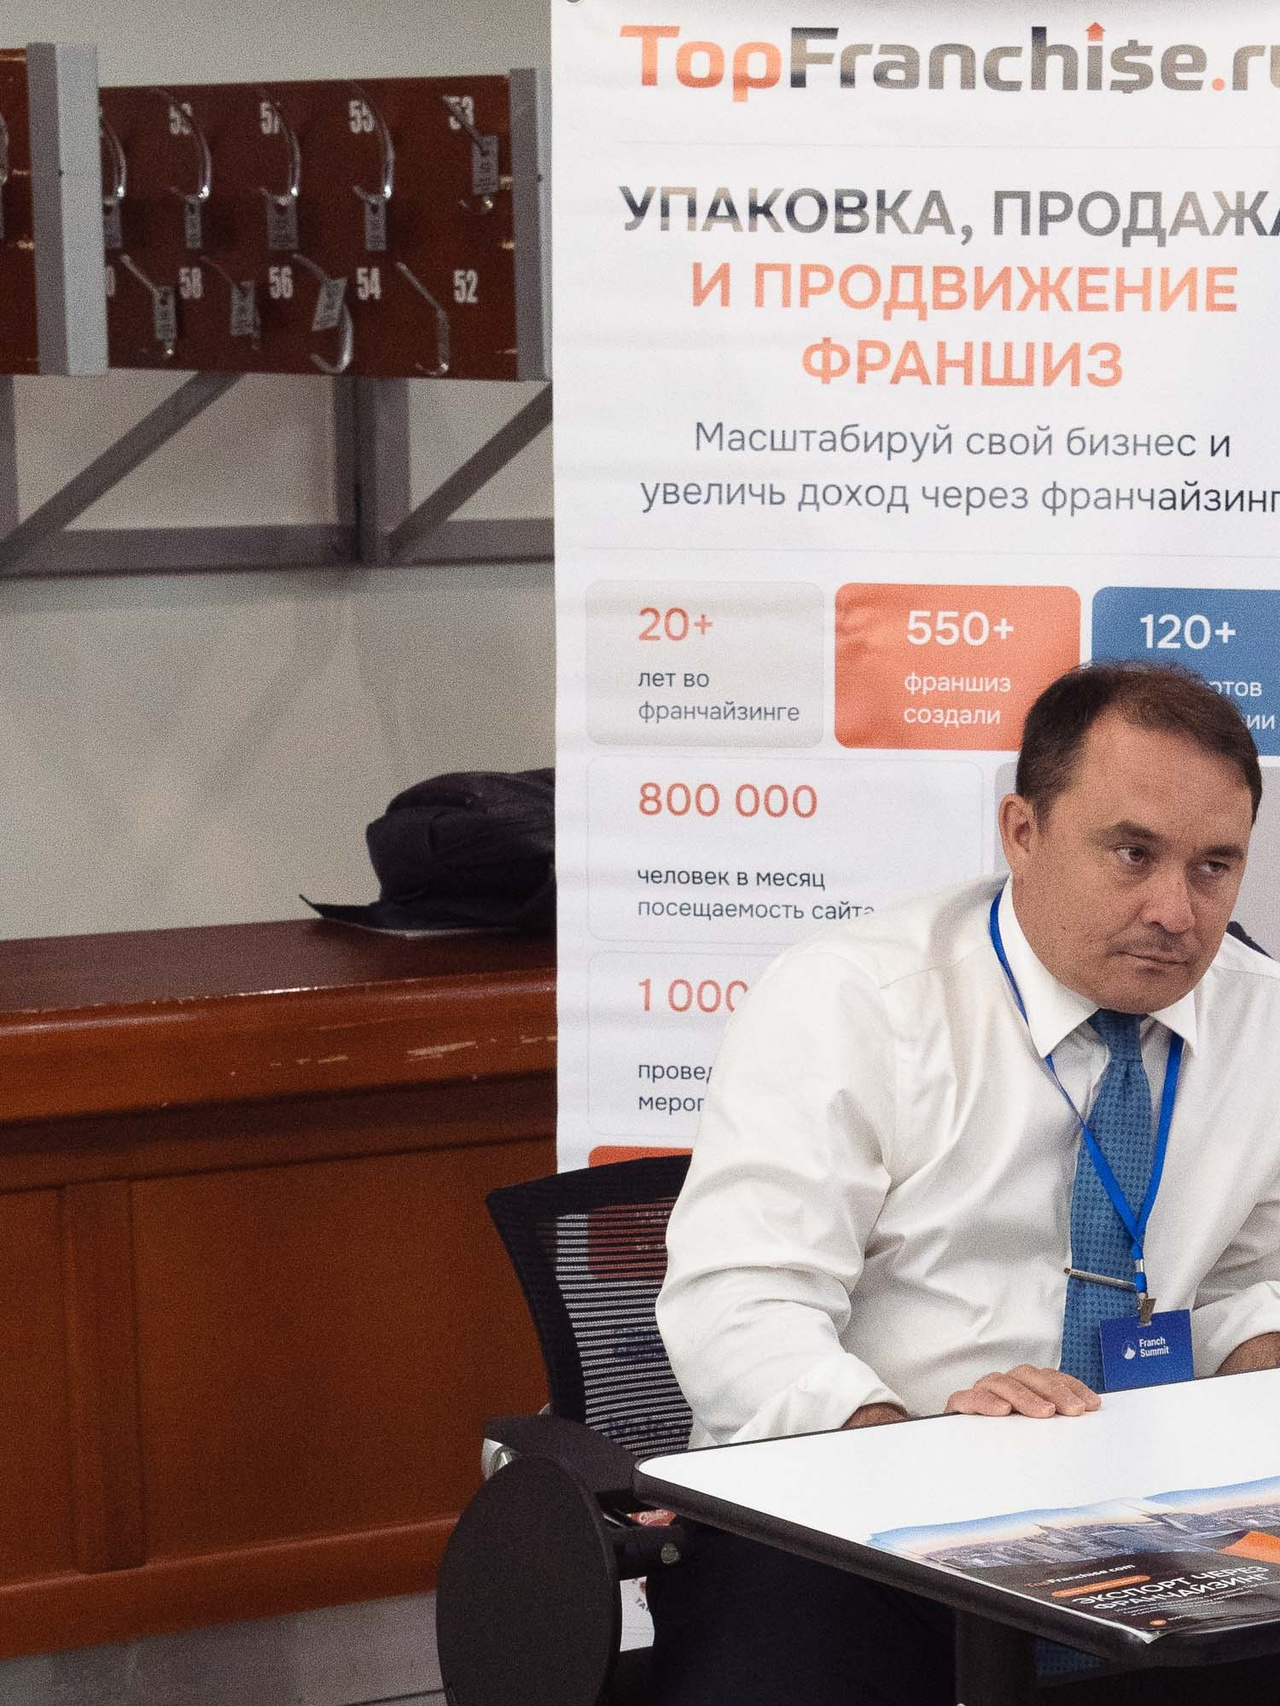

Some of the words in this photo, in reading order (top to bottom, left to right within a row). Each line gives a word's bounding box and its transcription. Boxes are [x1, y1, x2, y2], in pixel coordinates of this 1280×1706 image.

[619, 185, 973, 246] УПАКОВКА,
[268, 266, 293, 299] 56
[356, 267, 381, 300] 54
[453, 269, 478, 303] 52
[692, 262, 730, 308] И
[755, 263, 1238, 321] ПРОДВИЖЕНИЕ
[802, 337, 1123, 387] ФРАНШИЗ
[696, 422, 952, 462] Масштабируй
[966, 425, 1052, 456] свой
[1066, 427, 1197, 457] бизнес
[1210, 434, 1230, 457] и
[641, 482, 785, 513] увеличь
[798, 484, 909, 513] доход
[922, 484, 1028, 516] через
[638, 607, 714, 642] 20+
[906, 610, 1014, 646] 550+
[1140, 614, 1236, 650] 120+
[638, 672, 675, 687] лет
[684, 672, 709, 687] во
[904, 671, 1010, 694] франшиз
[638, 701, 800, 723] франчайзинге
[904, 705, 1000, 726] создали
[639, 782, 720, 816] 800
[735, 784, 817, 818] 000
[638, 869, 730, 885] человек
[737, 871, 748, 885] в
[756, 872, 825, 890] месяц
[638, 901, 804, 920] посещаемость
[639, 978, 651, 1011] 1
[1139, 1337, 1166, 1348] Franch
[1140, 1346, 1170, 1358] Summit
[1072, 1577, 1191, 1605] ЭКСПОРТ
[1190, 1566, 1270, 1581] ЧЕРЕЗ
[1093, 1573, 1270, 1611] ФРАНЧАЙЗИНГ
